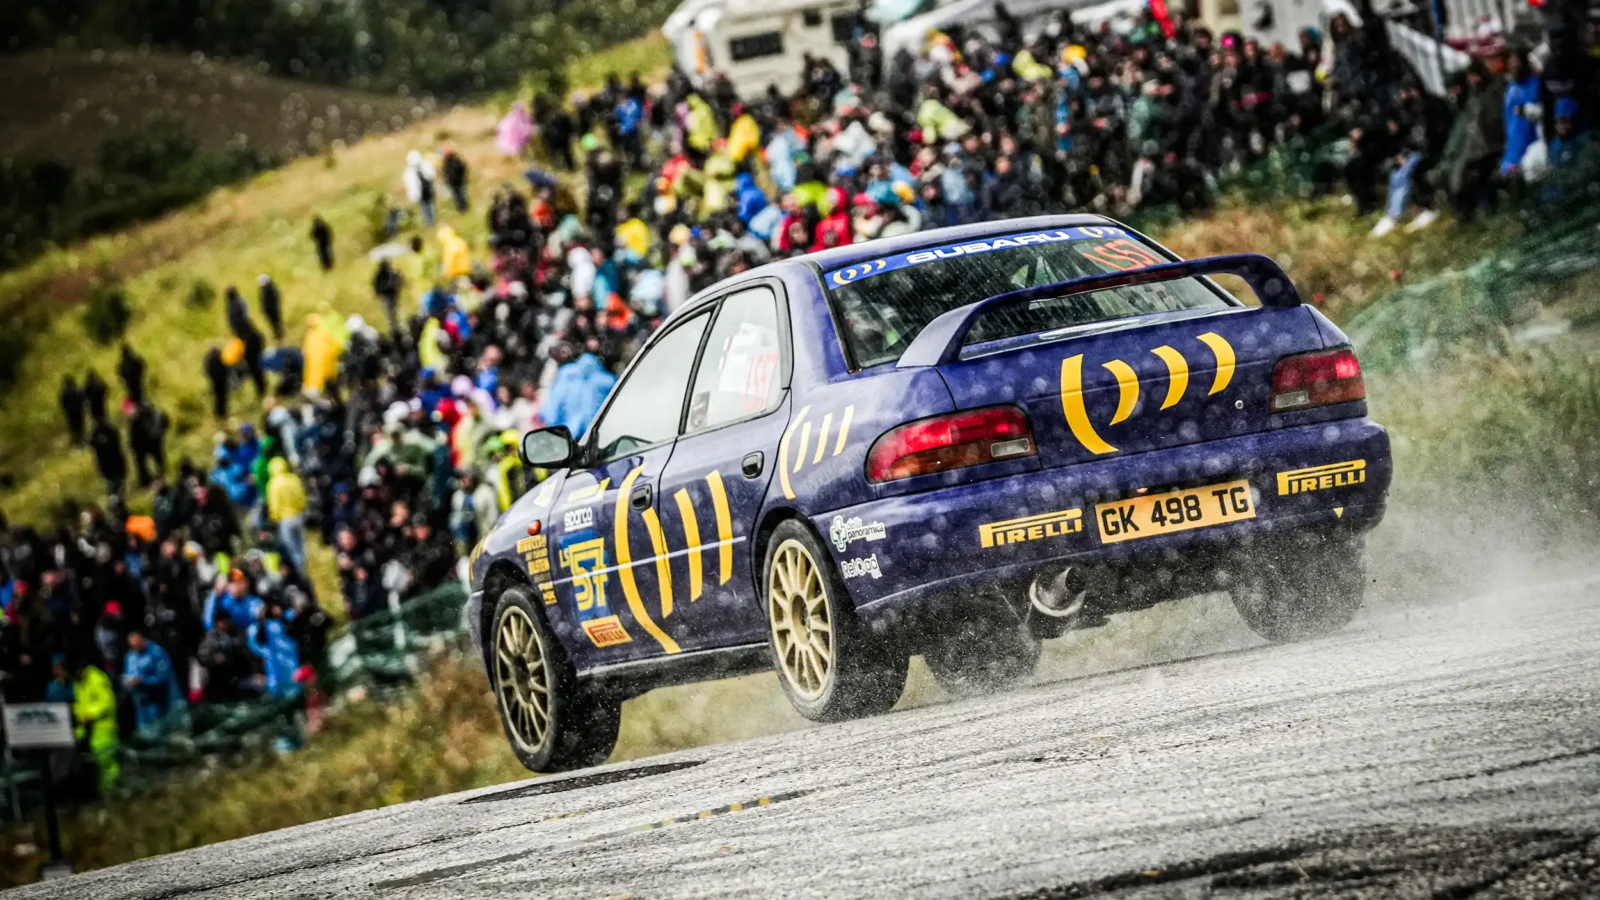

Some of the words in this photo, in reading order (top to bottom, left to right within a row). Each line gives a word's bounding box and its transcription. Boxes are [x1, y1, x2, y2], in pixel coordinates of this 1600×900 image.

[906, 231, 1070, 264] SUBARU
[1276, 458, 1366, 496] PIRELLI
[978, 508, 1083, 549] PIRELLI
[1101, 505, 1139, 536] GK
[1150, 494, 1203, 527] 498
[1212, 486, 1250, 516] TG
[587, 621, 627, 644] PIRELLI
